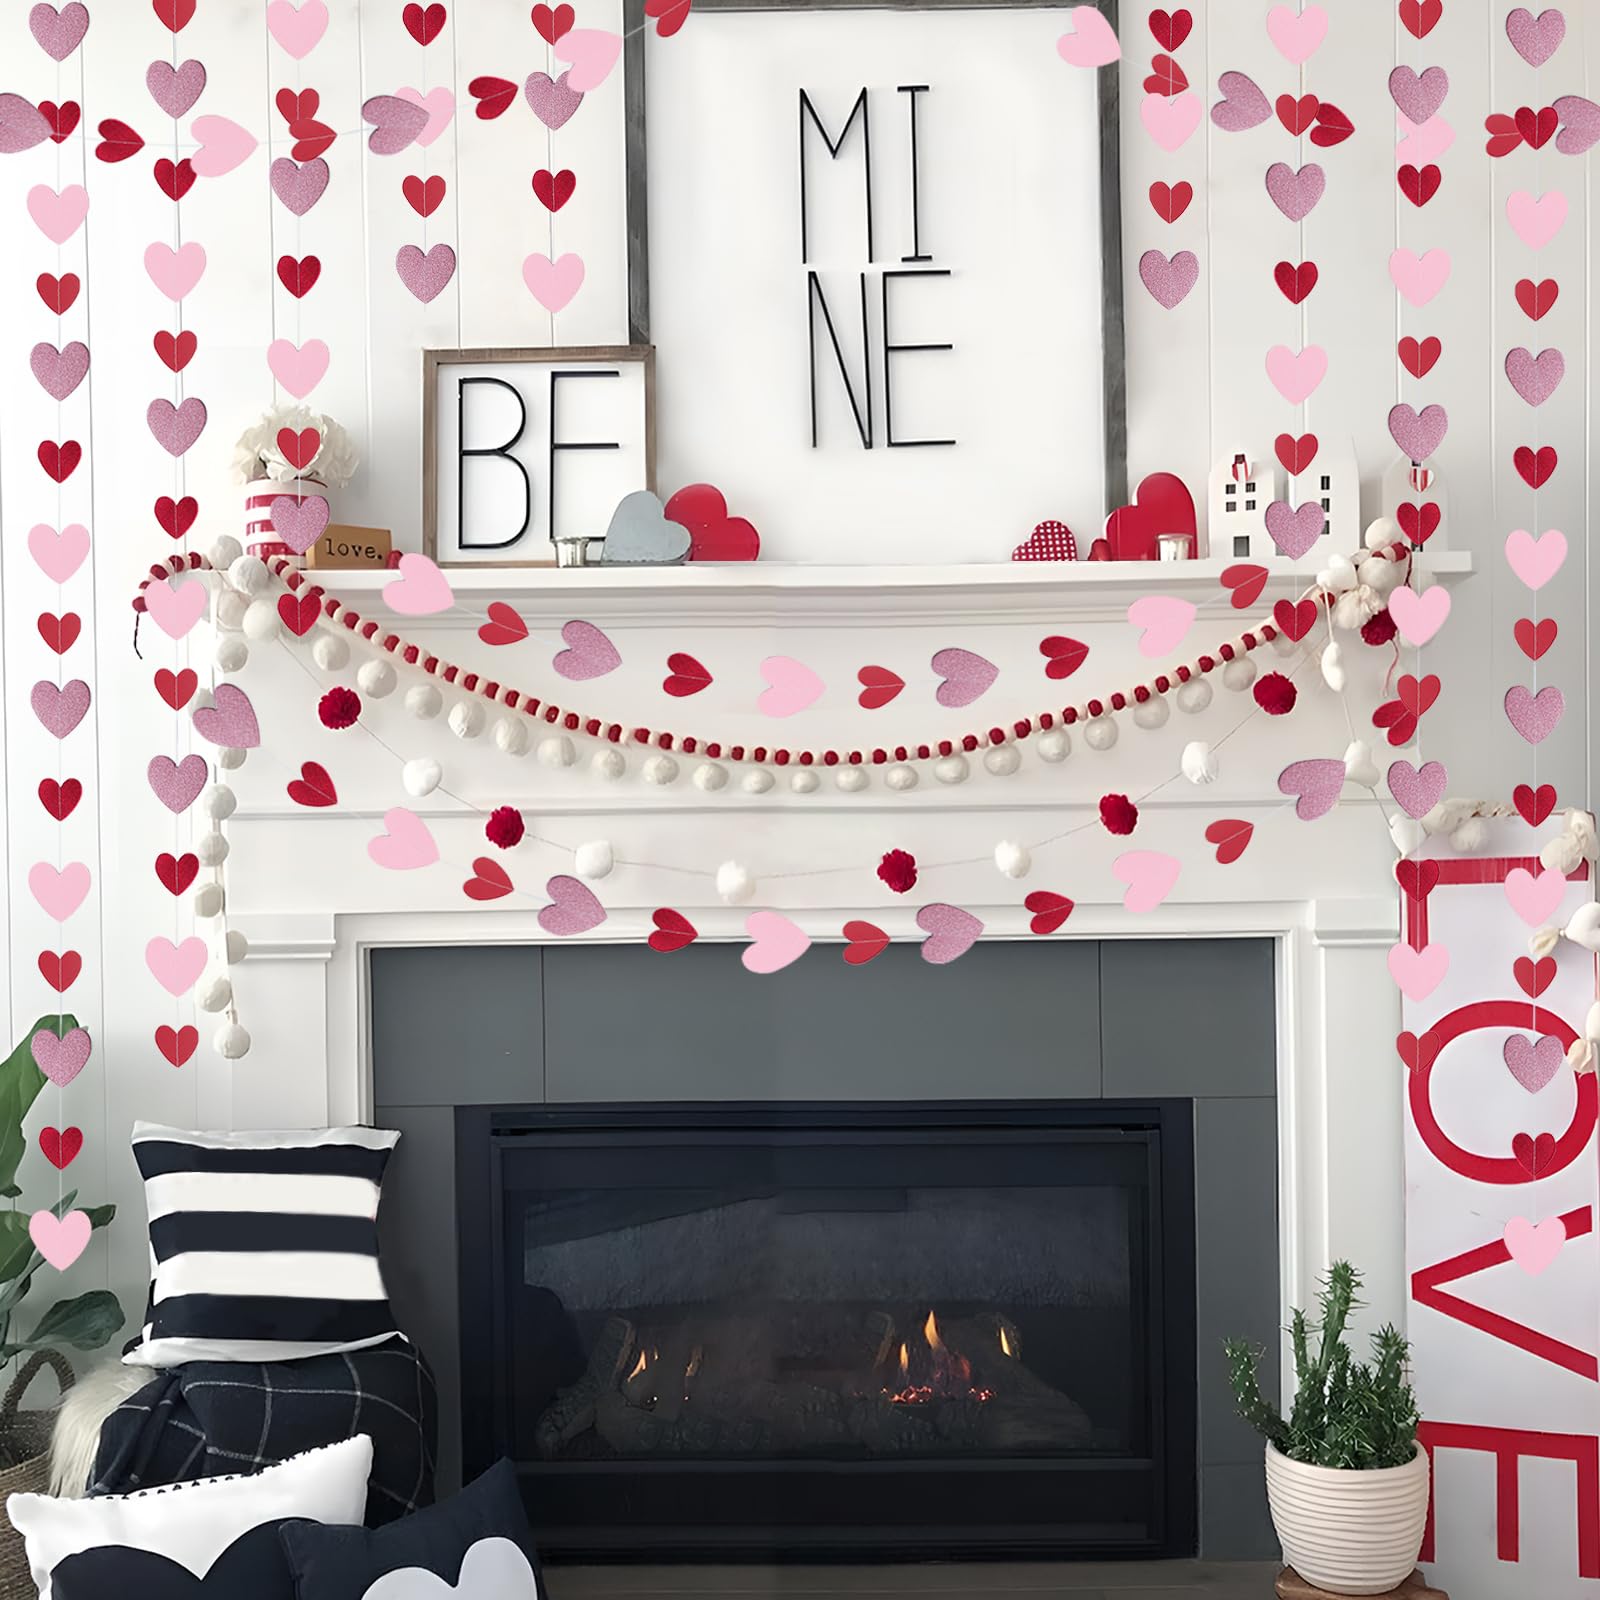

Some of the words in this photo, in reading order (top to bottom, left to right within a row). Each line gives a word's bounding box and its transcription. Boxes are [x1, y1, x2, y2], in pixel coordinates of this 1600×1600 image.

[325, 538, 383, 560] love.
[458, 371, 620, 550] BE
[1407, 857, 1599, 1579] LOVE
